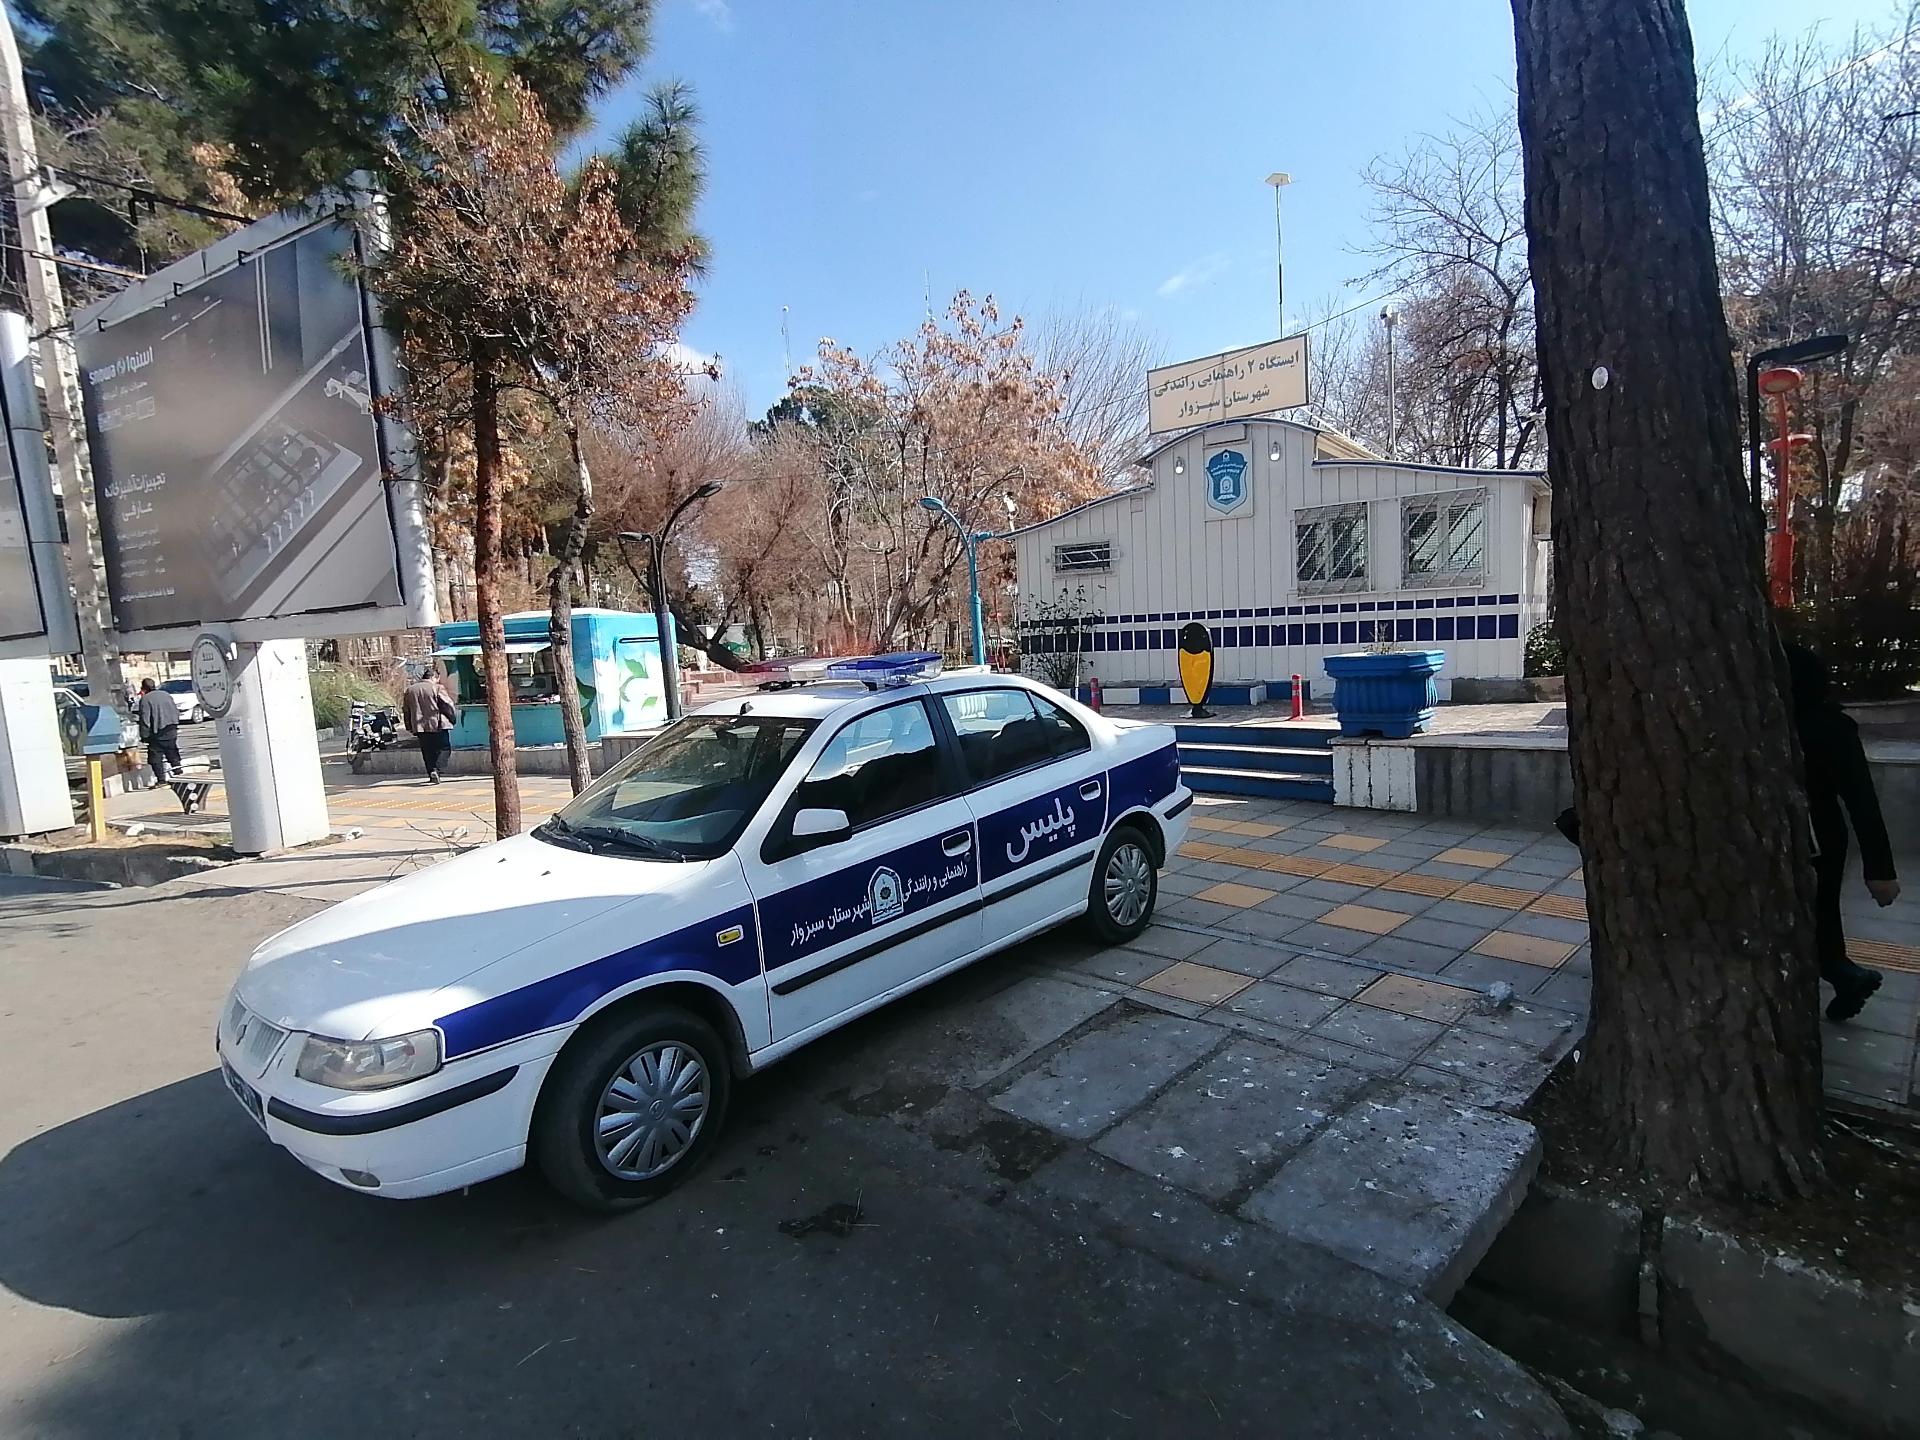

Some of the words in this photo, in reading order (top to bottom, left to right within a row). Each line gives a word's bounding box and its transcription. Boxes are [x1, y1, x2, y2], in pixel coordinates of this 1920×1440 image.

[1258, 350, 1299, 372] ایستگاه
[1153, 375, 1195, 398] رانندگی
[1197, 364, 1245, 389] راهنمایی
[1177, 398, 1221, 418] سبزوار
[1223, 383, 1271, 409] شهرستان
[1005, 797, 1076, 863] پلیس
[901, 871, 933, 903] رانندگی
[932, 879, 939, 892] و
[937, 860, 969, 888] راهنمایی
[826, 892, 871, 931] شهرستان
[790, 918, 825, 946] سبزوار
